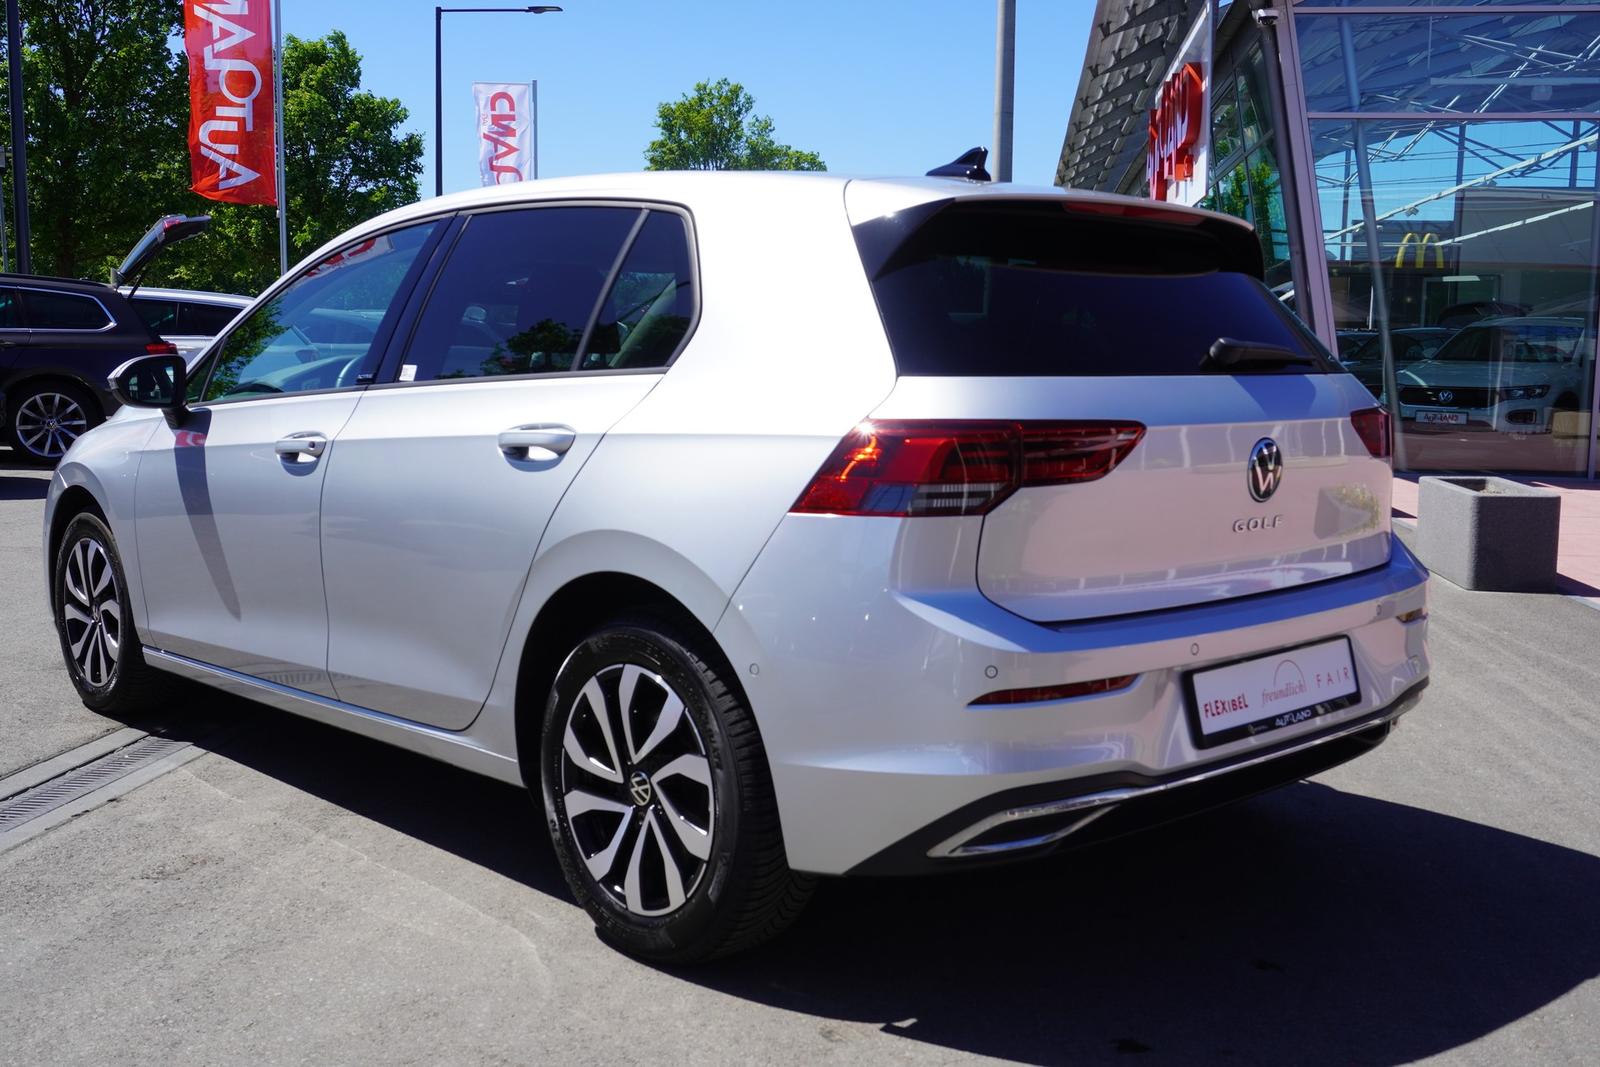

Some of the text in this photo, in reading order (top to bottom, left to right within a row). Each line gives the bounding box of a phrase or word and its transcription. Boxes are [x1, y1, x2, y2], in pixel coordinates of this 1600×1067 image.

[1232, 513, 1285, 533] GOLF
[1203, 693, 1249, 719] FLEXIBEL
[1315, 666, 1351, 689] FAIR
